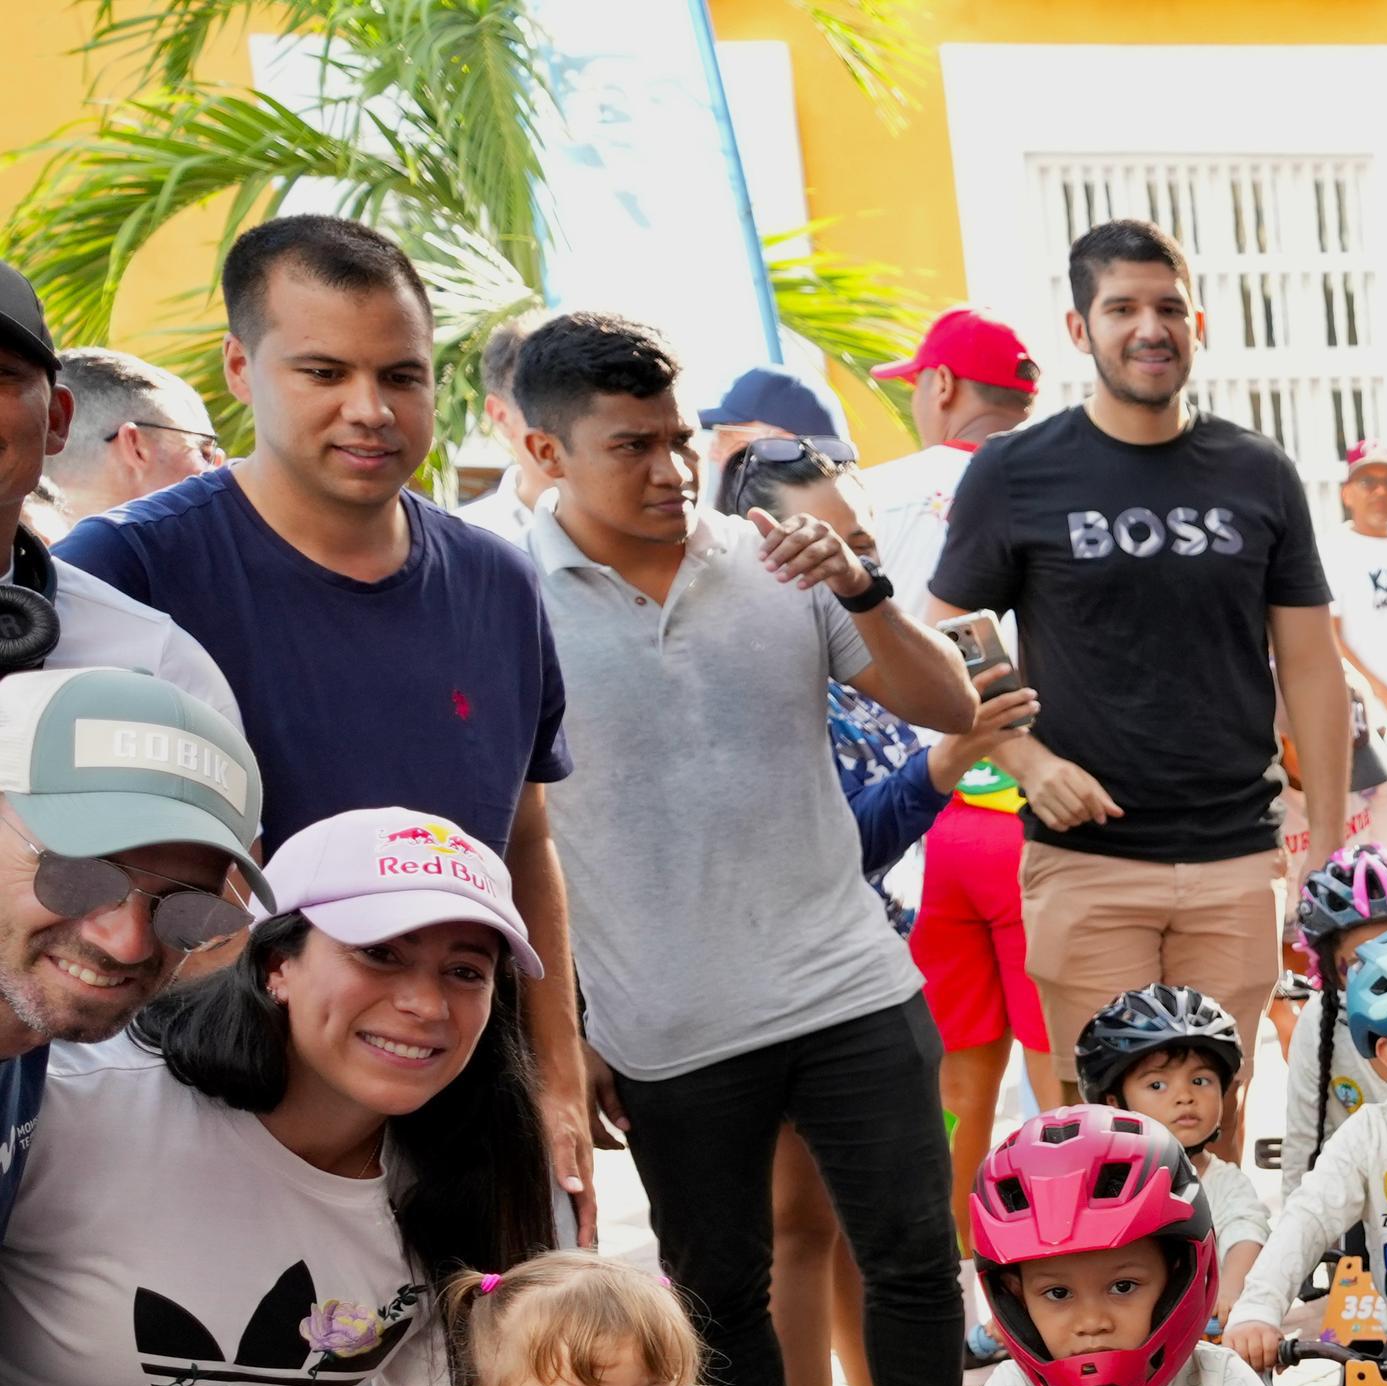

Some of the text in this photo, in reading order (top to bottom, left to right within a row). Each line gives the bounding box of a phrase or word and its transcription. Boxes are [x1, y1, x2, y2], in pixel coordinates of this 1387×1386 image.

[1067, 506, 1244, 560] BOSS
[112, 729, 230, 790] GOBIK
[379, 856, 499, 899] Red Bull
